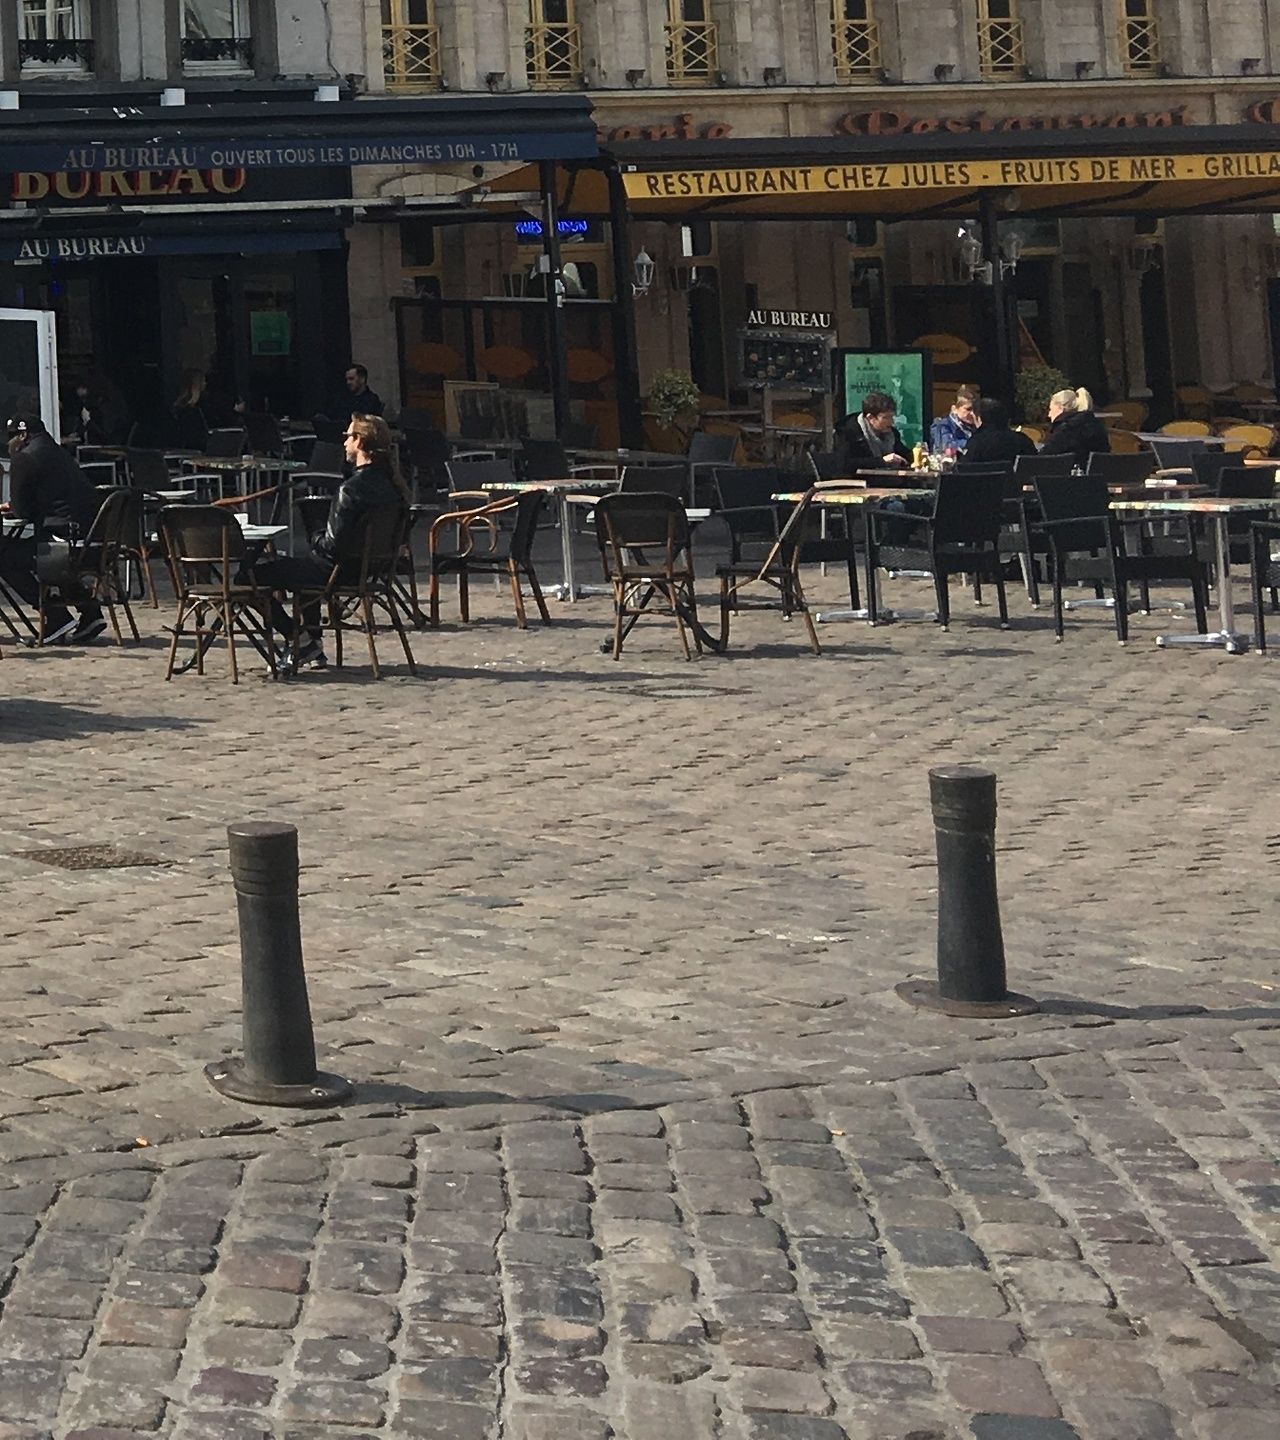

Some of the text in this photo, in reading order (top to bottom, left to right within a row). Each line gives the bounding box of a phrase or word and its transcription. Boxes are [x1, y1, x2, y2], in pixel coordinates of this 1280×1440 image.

[63, 149, 96, 169] AU
[103, 148, 198, 168] BUREAU
[211, 149, 271, 166] OUVERT
[276, 148, 315, 164] TOUS
[320, 147, 344, 163] LES
[349, 145, 441, 162] DIMANCHES
[447, 144, 476, 159] 10H
[490, 143, 519, 158] 17H
[646, 168, 812, 196] RESTAURANT
[823, 166, 891, 190] CHEZ
[900, 163, 971, 187] JULES
[1000, 160, 1081, 184] FRUITS
[1091, 159, 1120, 181] DE
[1130, 157, 1176, 180] MER
[1204, 154, 1280, 177] GRILLA
[18, 236, 146, 258] AU BUREAU
[748, 310, 831, 328] AU BUREAU
